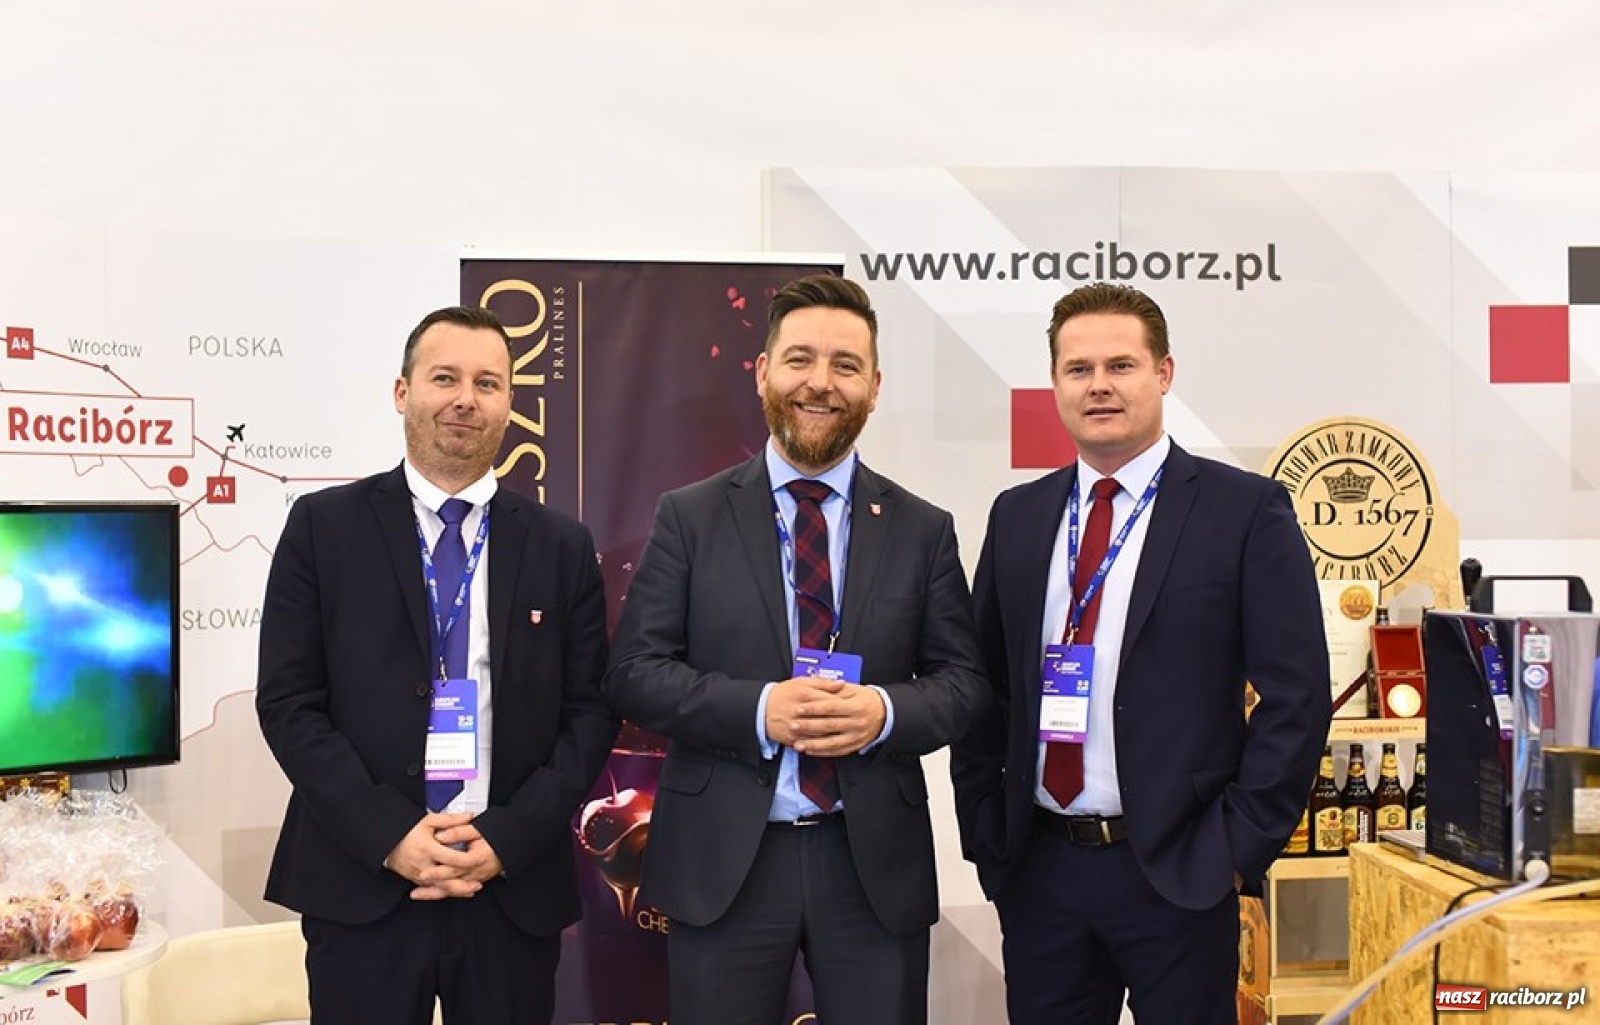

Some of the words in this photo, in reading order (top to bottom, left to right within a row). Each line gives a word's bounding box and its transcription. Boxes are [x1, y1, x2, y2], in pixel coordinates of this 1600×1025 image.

[860, 241, 1281, 290] www.raciborz.pl
[11, 336, 31, 351] A4
[68, 338, 143, 358] Wrocław
[188, 335, 284, 358] POLSKA
[553, 286, 565, 379] PRALINES
[480, 279, 549, 505] SZKO
[8, 405, 173, 446] Racibórz
[244, 443, 332, 459] Katowice
[212, 484, 230, 498] A1
[1303, 501, 1342, 526] .D.
[1354, 492, 1420, 536] 1567
